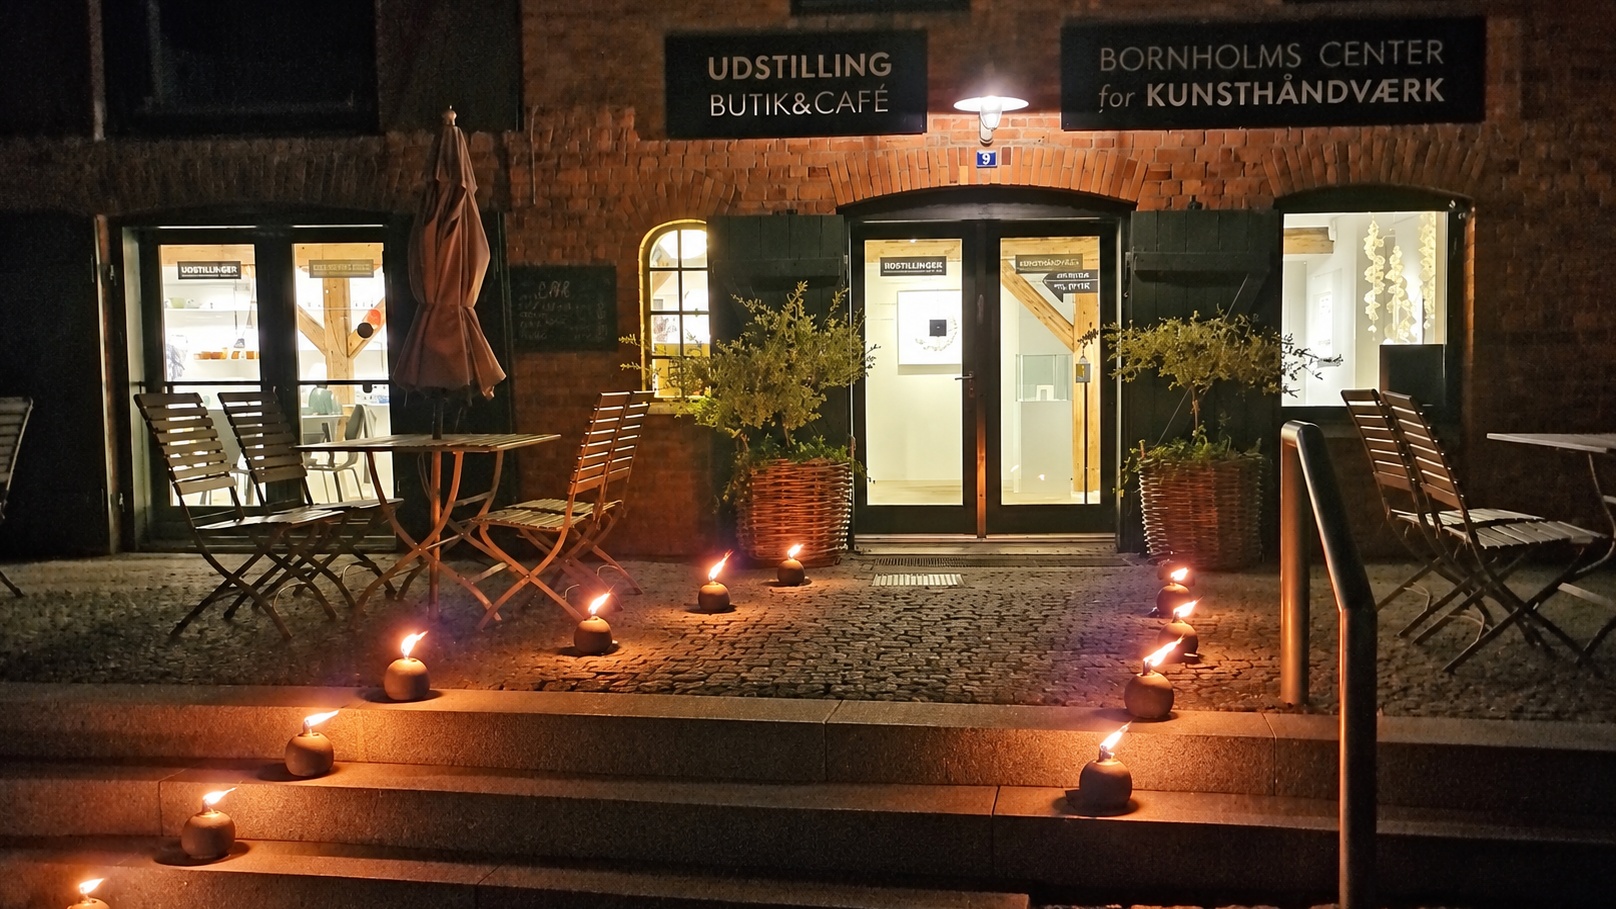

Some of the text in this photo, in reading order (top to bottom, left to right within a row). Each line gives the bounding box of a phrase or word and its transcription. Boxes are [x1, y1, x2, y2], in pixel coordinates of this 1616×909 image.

[708, 52, 892, 81] UDSTILLING
[1099, 40, 1445, 72] BORNHOLMS CENTER
[710, 83, 889, 117] BUTIK&CAFÉ
[1098, 74, 1445, 113] for KUNSTHÅNDVÆRK
[982, 153, 991, 165] 9
